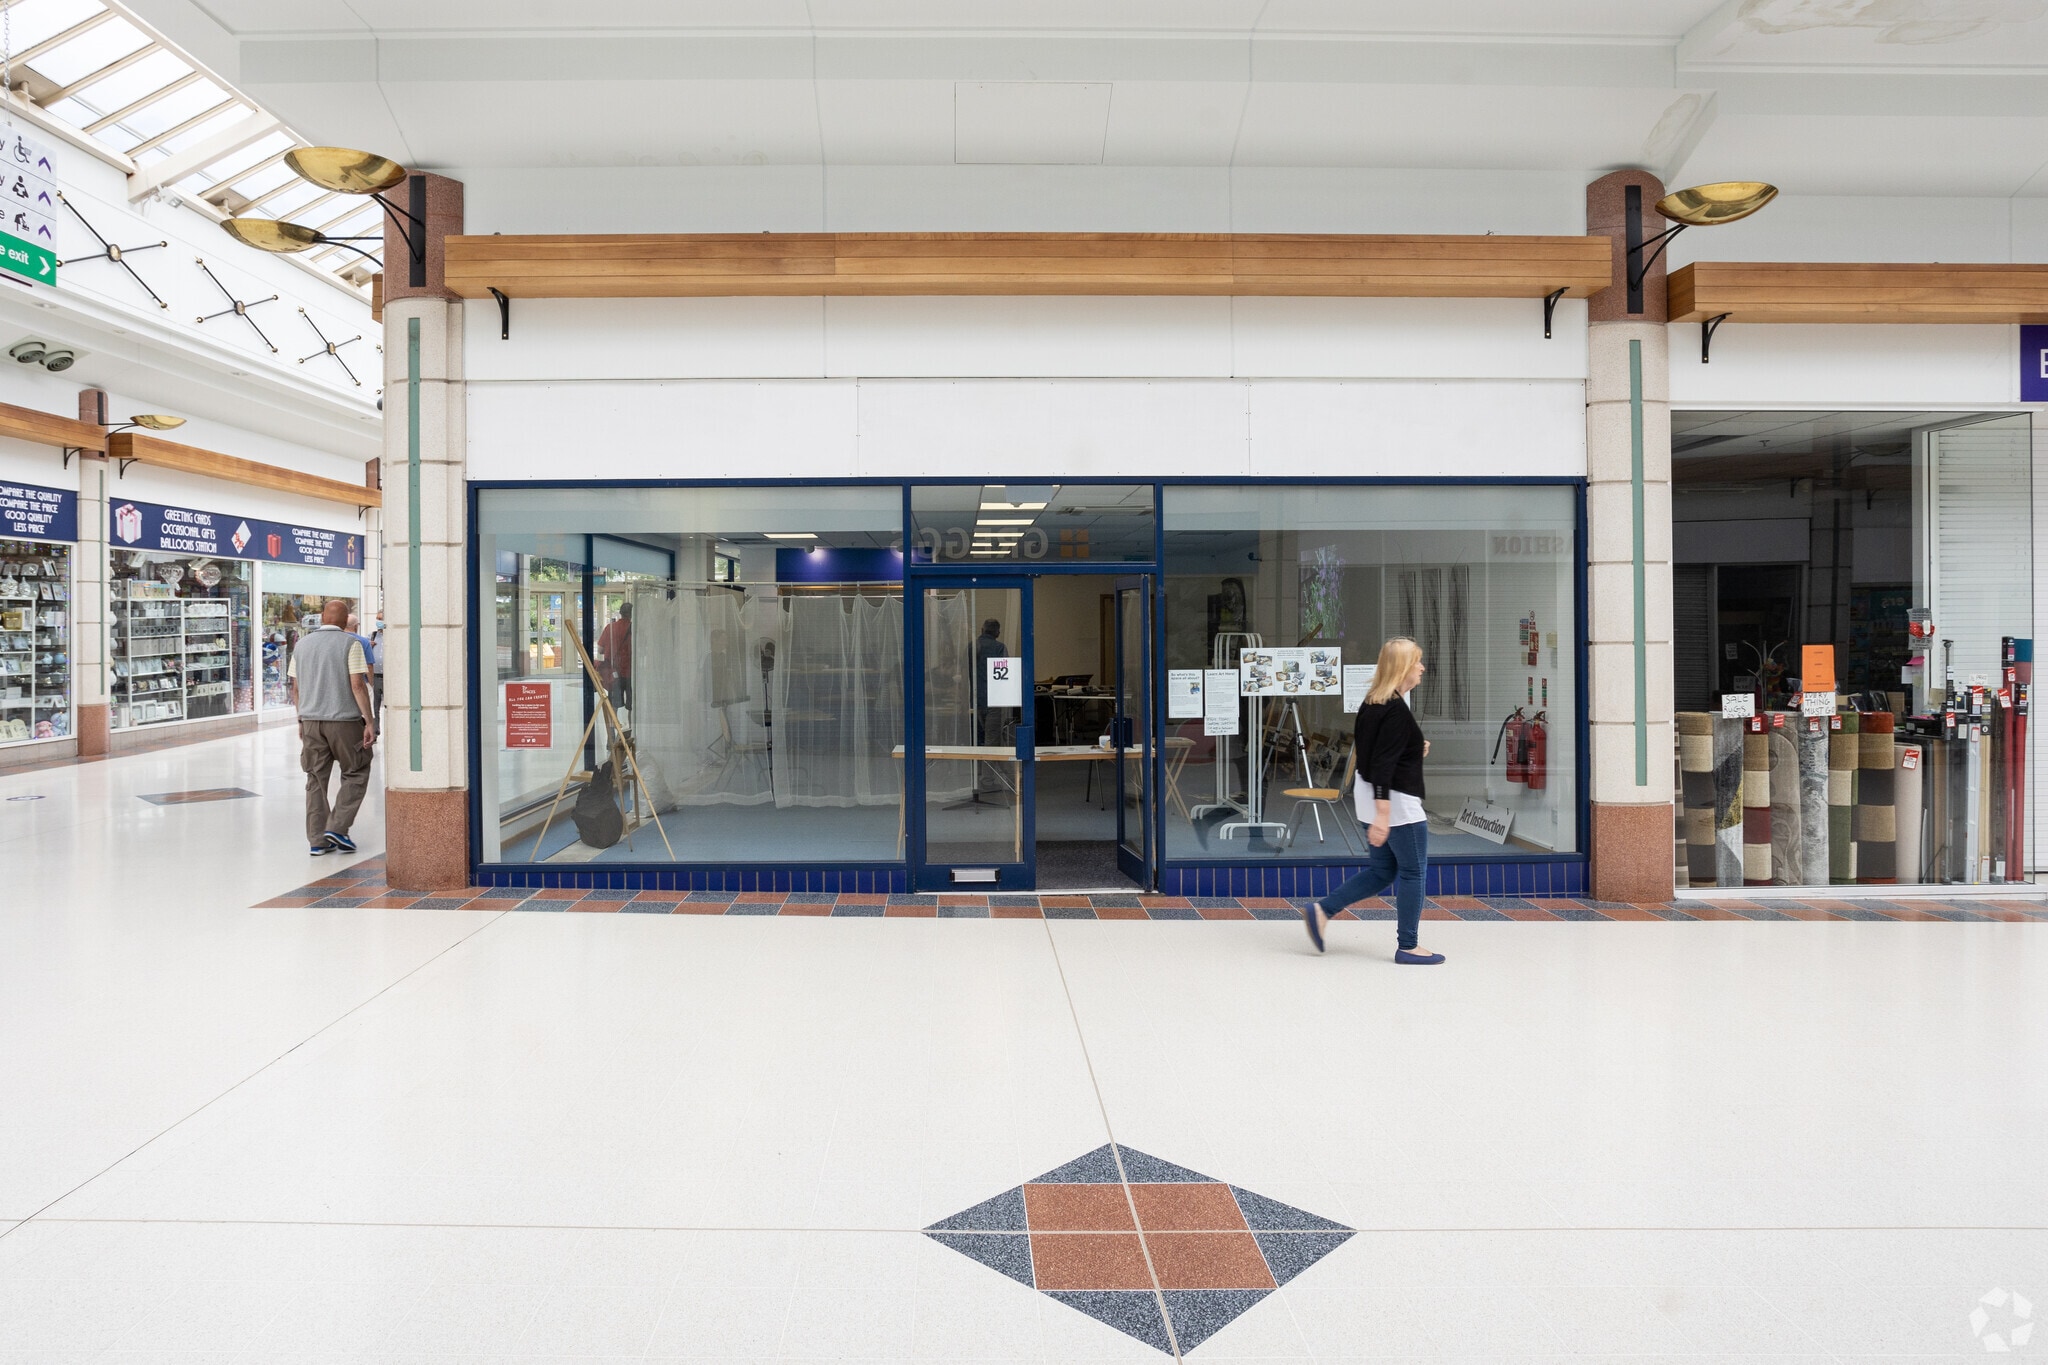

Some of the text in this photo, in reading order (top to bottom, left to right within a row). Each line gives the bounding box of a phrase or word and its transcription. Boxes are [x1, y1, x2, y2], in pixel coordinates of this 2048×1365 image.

[8, 248, 29, 265] exit
[0, 486, 62, 502] OMPARE THE QUALITY
[29, 501, 41, 512] THE
[42, 503, 59, 514] PRICE
[5, 510, 52, 524] GOOD QUALITY
[164, 509, 211, 526] GREETING CARDS
[13, 522, 45, 534] LESS PRICE
[161, 522, 216, 540] OCCASIONAL GIFTS
[160, 536, 217, 553] BALLOONS STATION
[994, 659, 1008, 668] unit
[993, 667, 1009, 680] 52
[1725, 694, 1749, 704] SALE
[1805, 698, 1831, 706] THING
[1723, 705, 1746, 713] RUGS
[1804, 706, 1825, 715] MUST
[1460, 808, 1506, 836] Art Instruction
